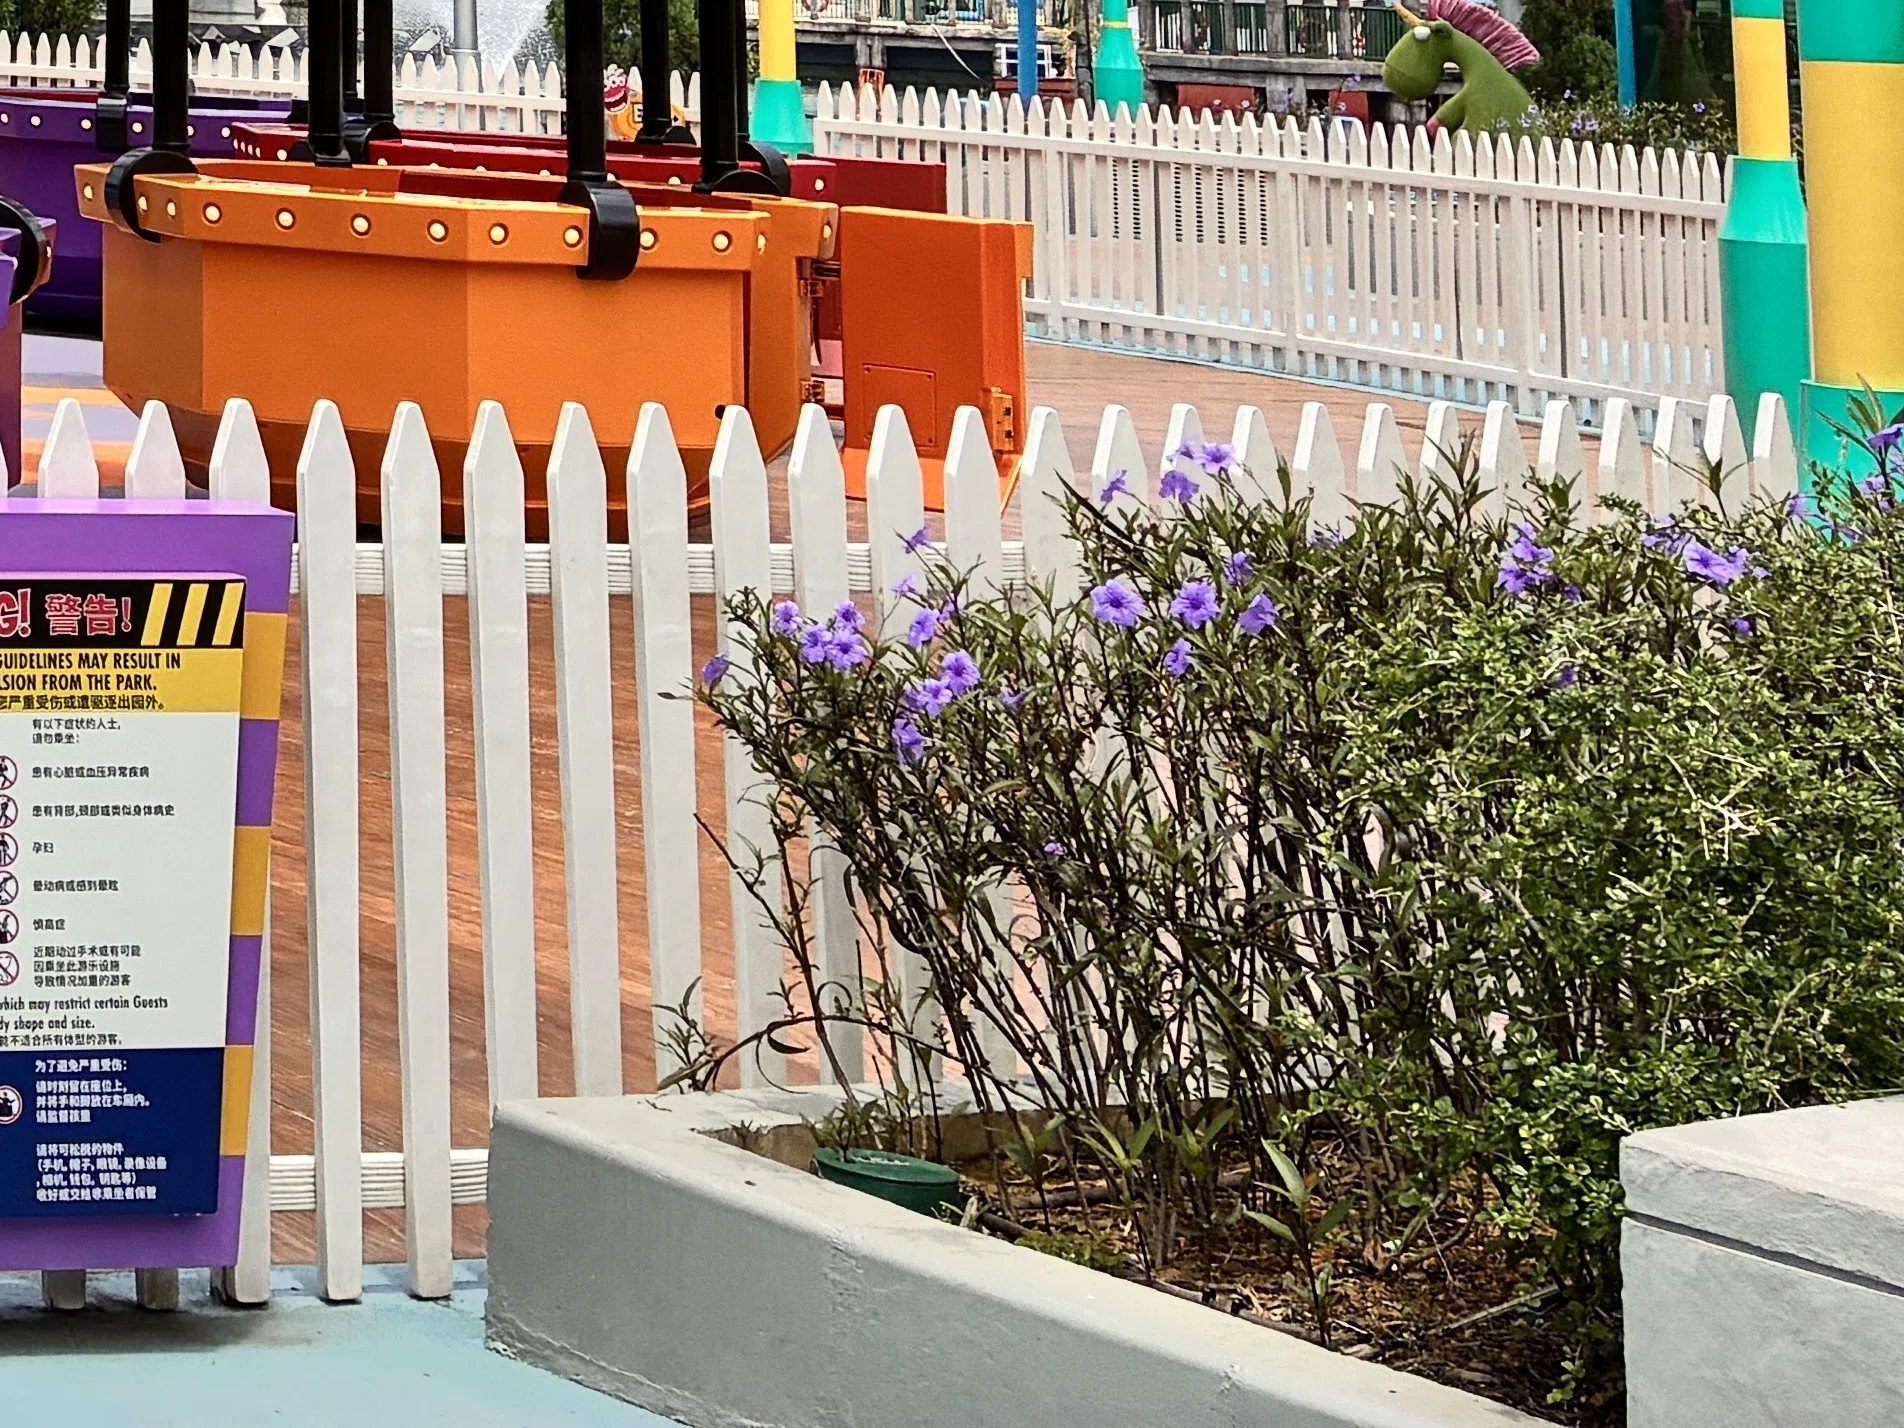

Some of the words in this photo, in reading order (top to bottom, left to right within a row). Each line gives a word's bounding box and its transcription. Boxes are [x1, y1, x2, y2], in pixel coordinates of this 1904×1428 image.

[78, 653, 108, 669] MAY
[114, 652, 162, 669] RESULT
[166, 652, 181, 669] IN
[42, 674, 82, 691] FROM
[87, 674, 111, 690] THE
[116, 674, 157, 691] PARK.
[29, 999, 51, 1014] may
[54, 996, 91, 1010] restrict
[94, 996, 130, 1009] certain
[133, 995, 168, 1009] Guests
[14, 1015, 44, 1032] shape
[48, 1014, 67, 1029] and
[71, 1016, 95, 1029] size.
